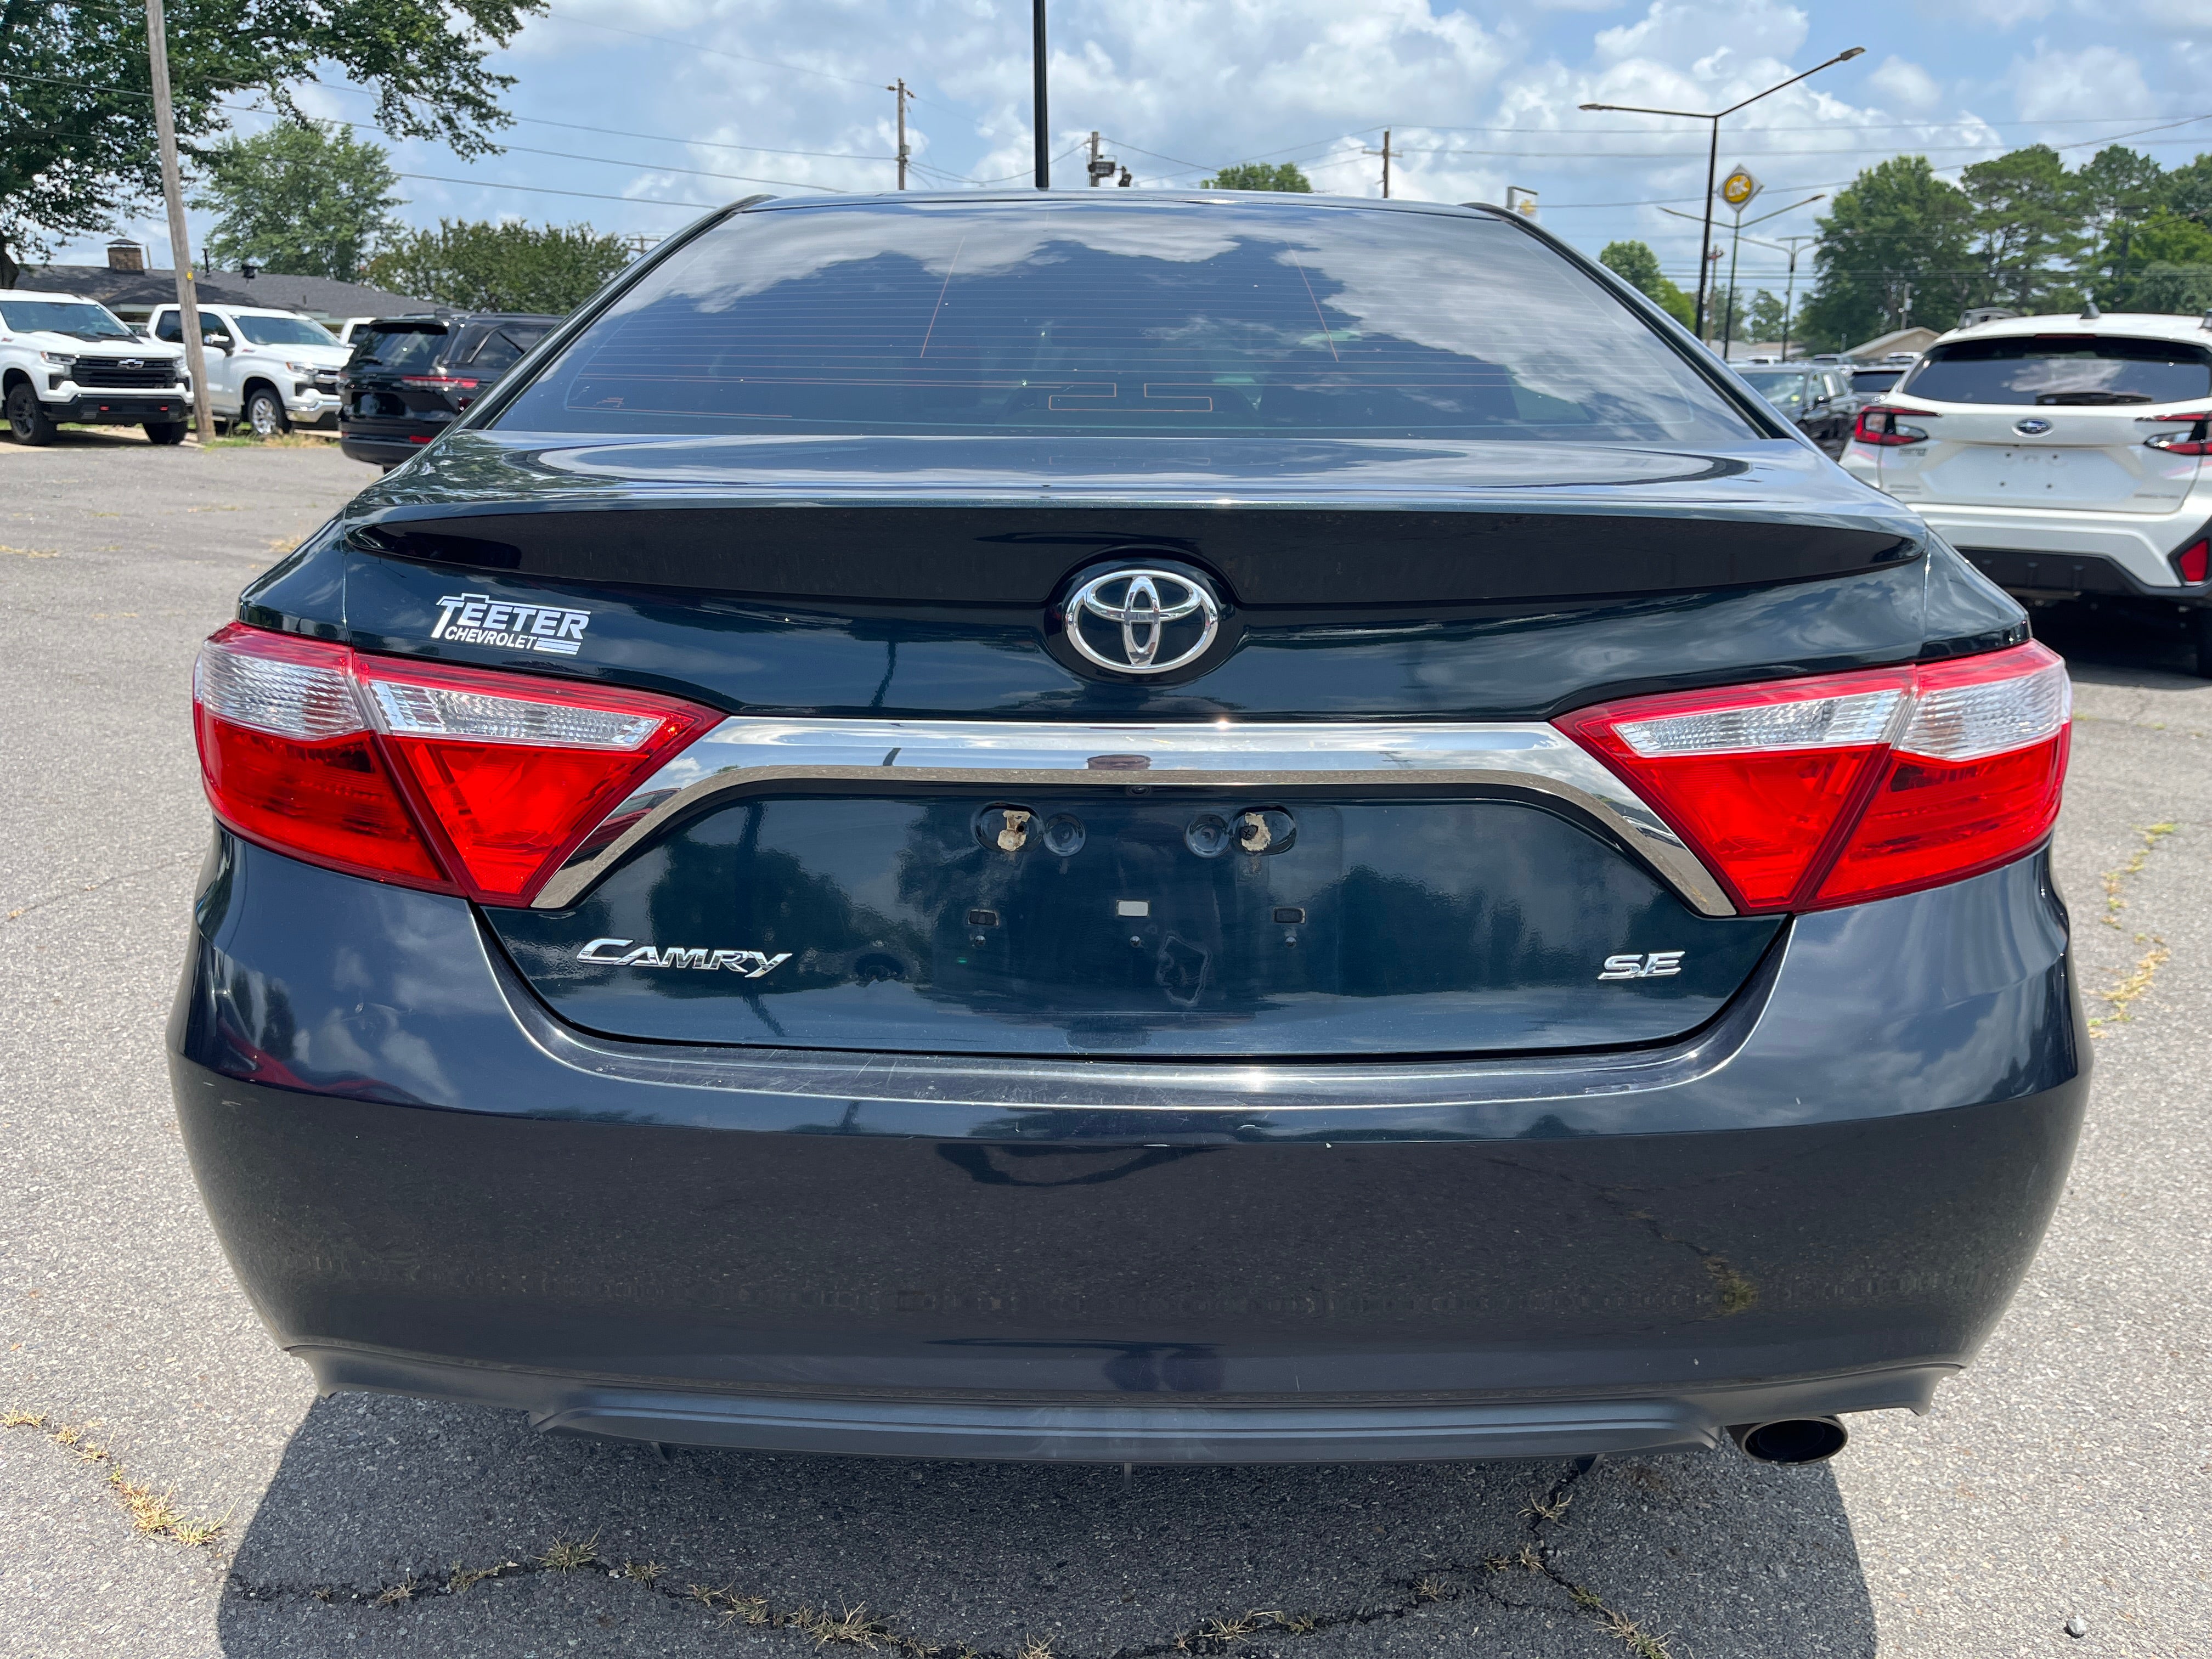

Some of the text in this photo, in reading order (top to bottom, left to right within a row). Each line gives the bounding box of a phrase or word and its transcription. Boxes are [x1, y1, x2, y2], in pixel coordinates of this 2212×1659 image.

[431, 600, 590, 640] TEETER
[445, 626, 537, 650] CHEVROLET
[576, 938, 793, 978] CAMRY
[1597, 951, 1686, 980] SE
